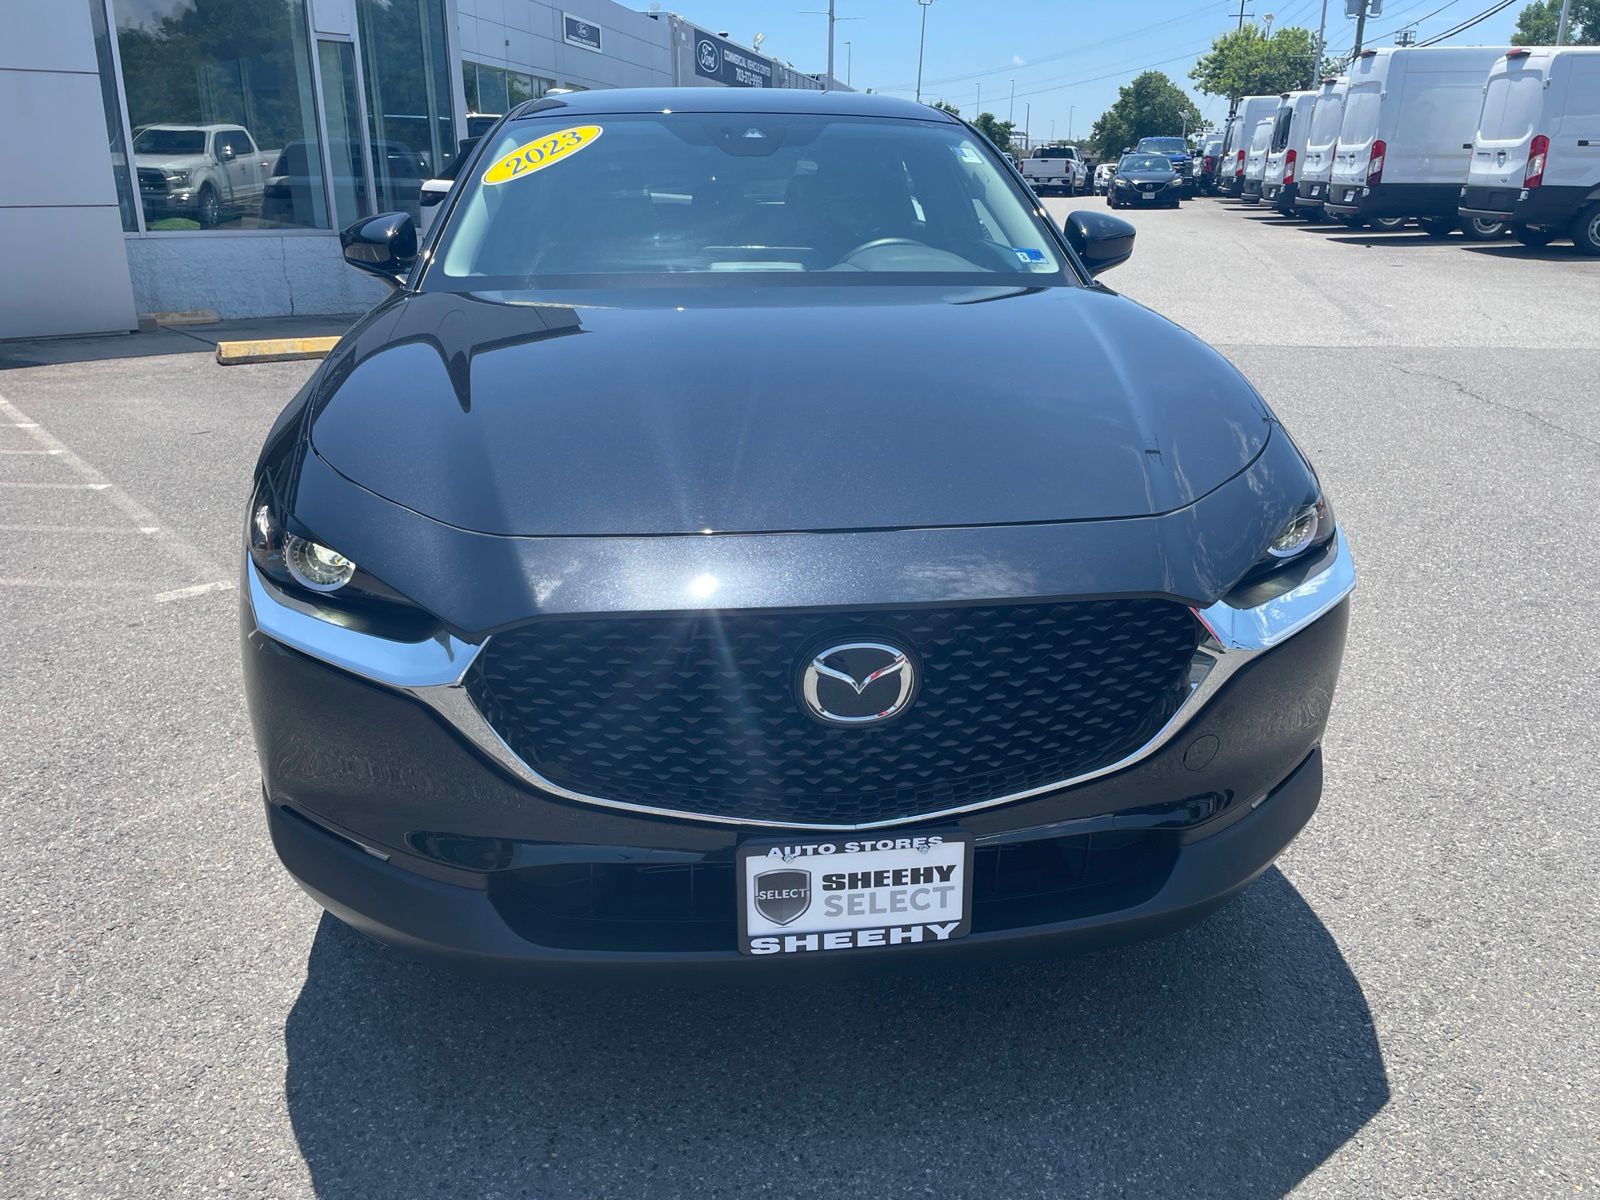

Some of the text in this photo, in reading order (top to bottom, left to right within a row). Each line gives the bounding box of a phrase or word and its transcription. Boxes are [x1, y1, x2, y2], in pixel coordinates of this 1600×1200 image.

[701, 43, 716, 68] Ford
[723, 49, 771, 77] COMMERCIAL VEHICLE CENTER
[506, 131, 582, 175] 2023
[766, 836, 943, 858] AUTO STORES
[822, 864, 957, 891] SHEEHY
[758, 888, 808, 900] SELECT
[824, 886, 955, 917] SELECT
[750, 922, 961, 955] SHEEHY
